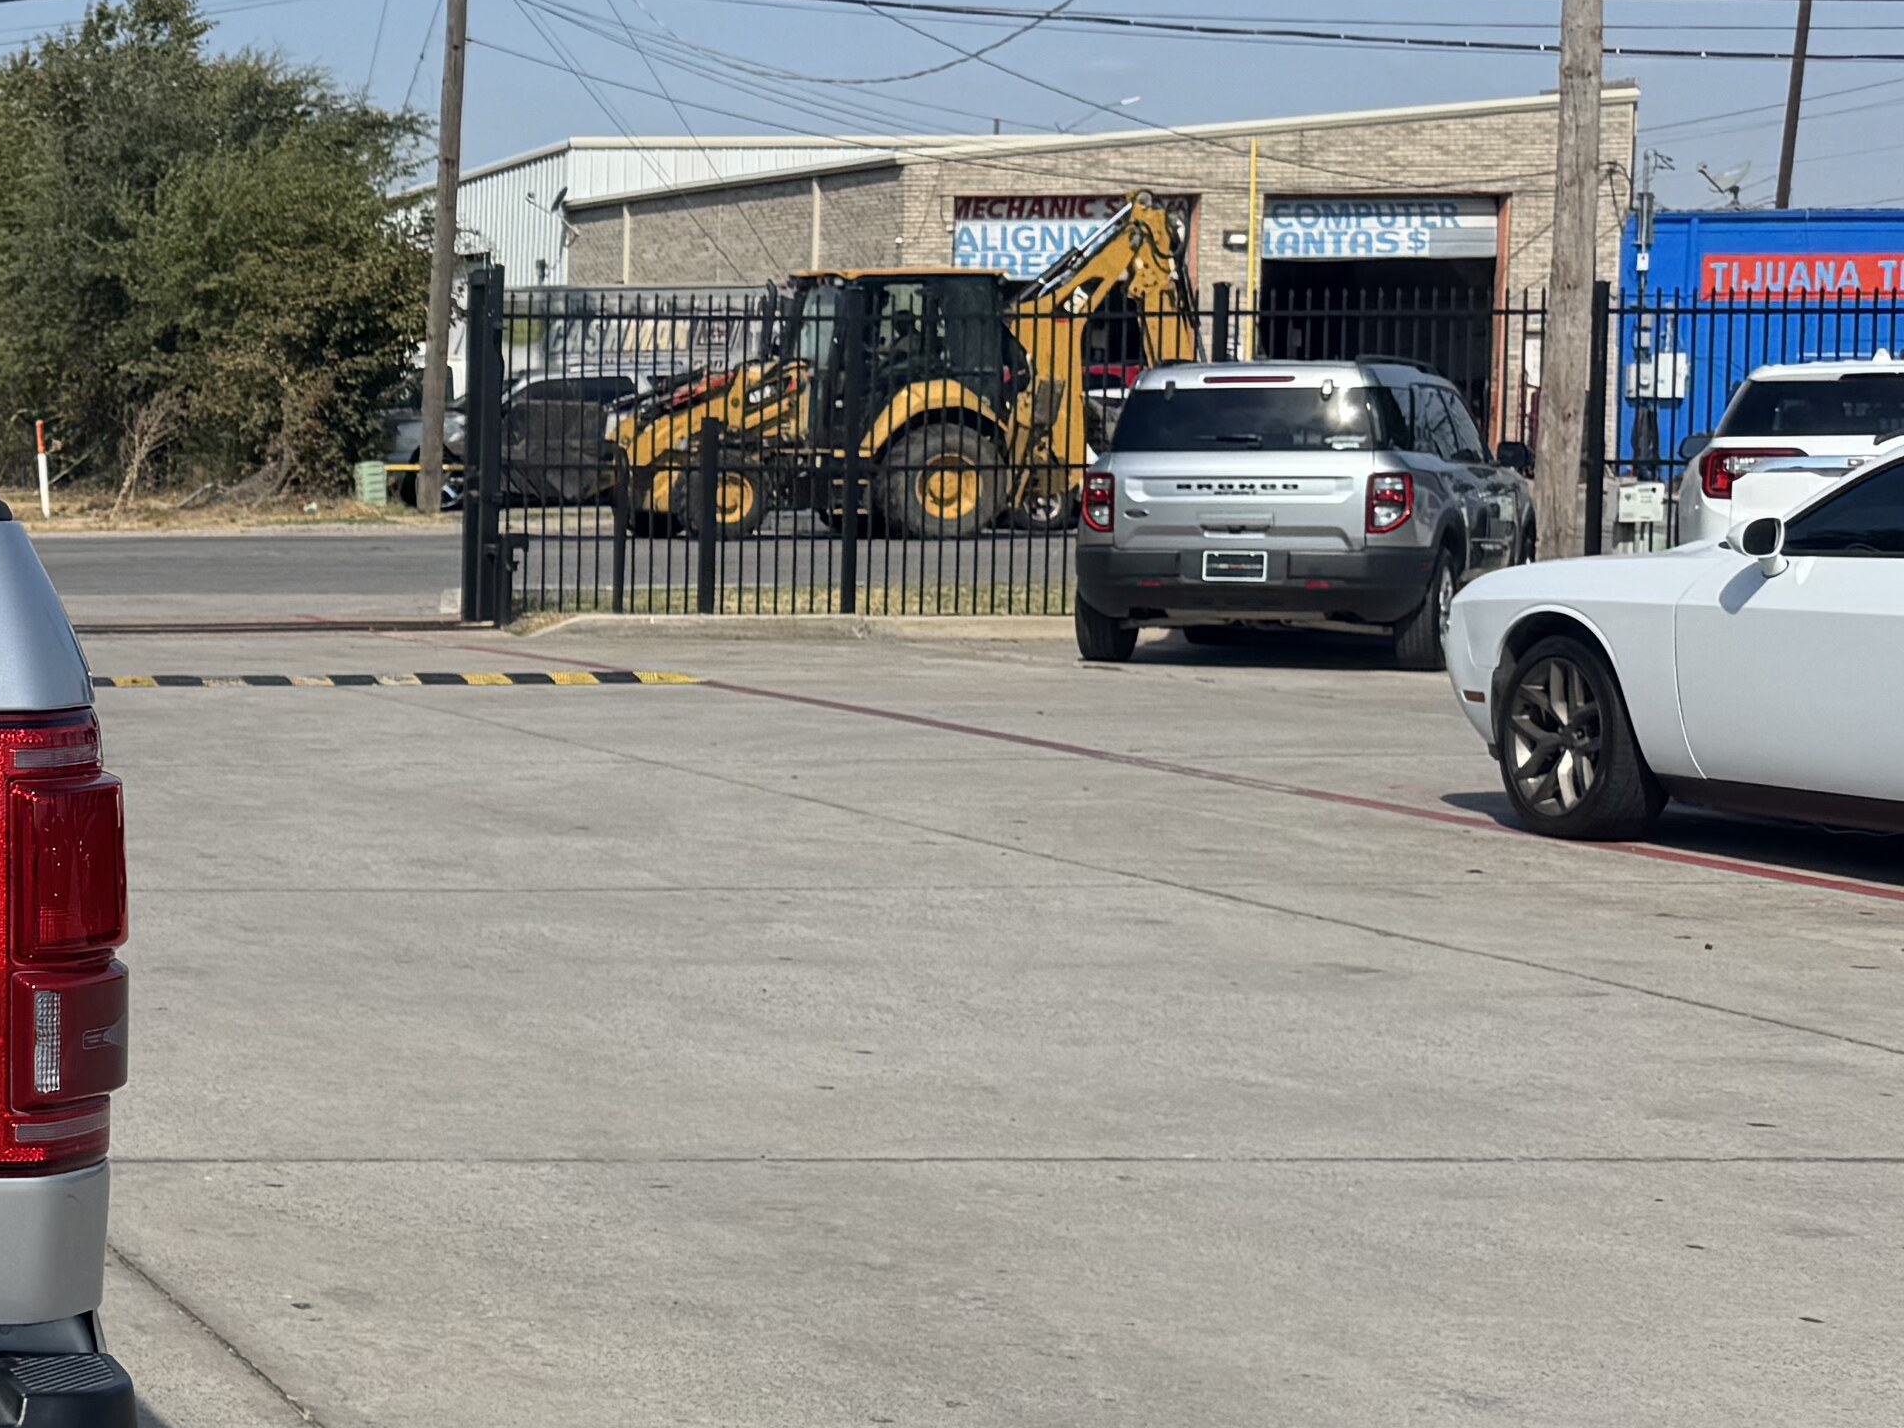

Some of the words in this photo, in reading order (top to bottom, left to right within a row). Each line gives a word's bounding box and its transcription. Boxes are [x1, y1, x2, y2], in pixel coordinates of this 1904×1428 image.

[956, 197, 1097, 220] MECHANIC
[1271, 203, 1461, 228] COMPUTER
[955, 224, 1099, 252] ALIGNM
[1709, 260, 1861, 293] TIJUANA
